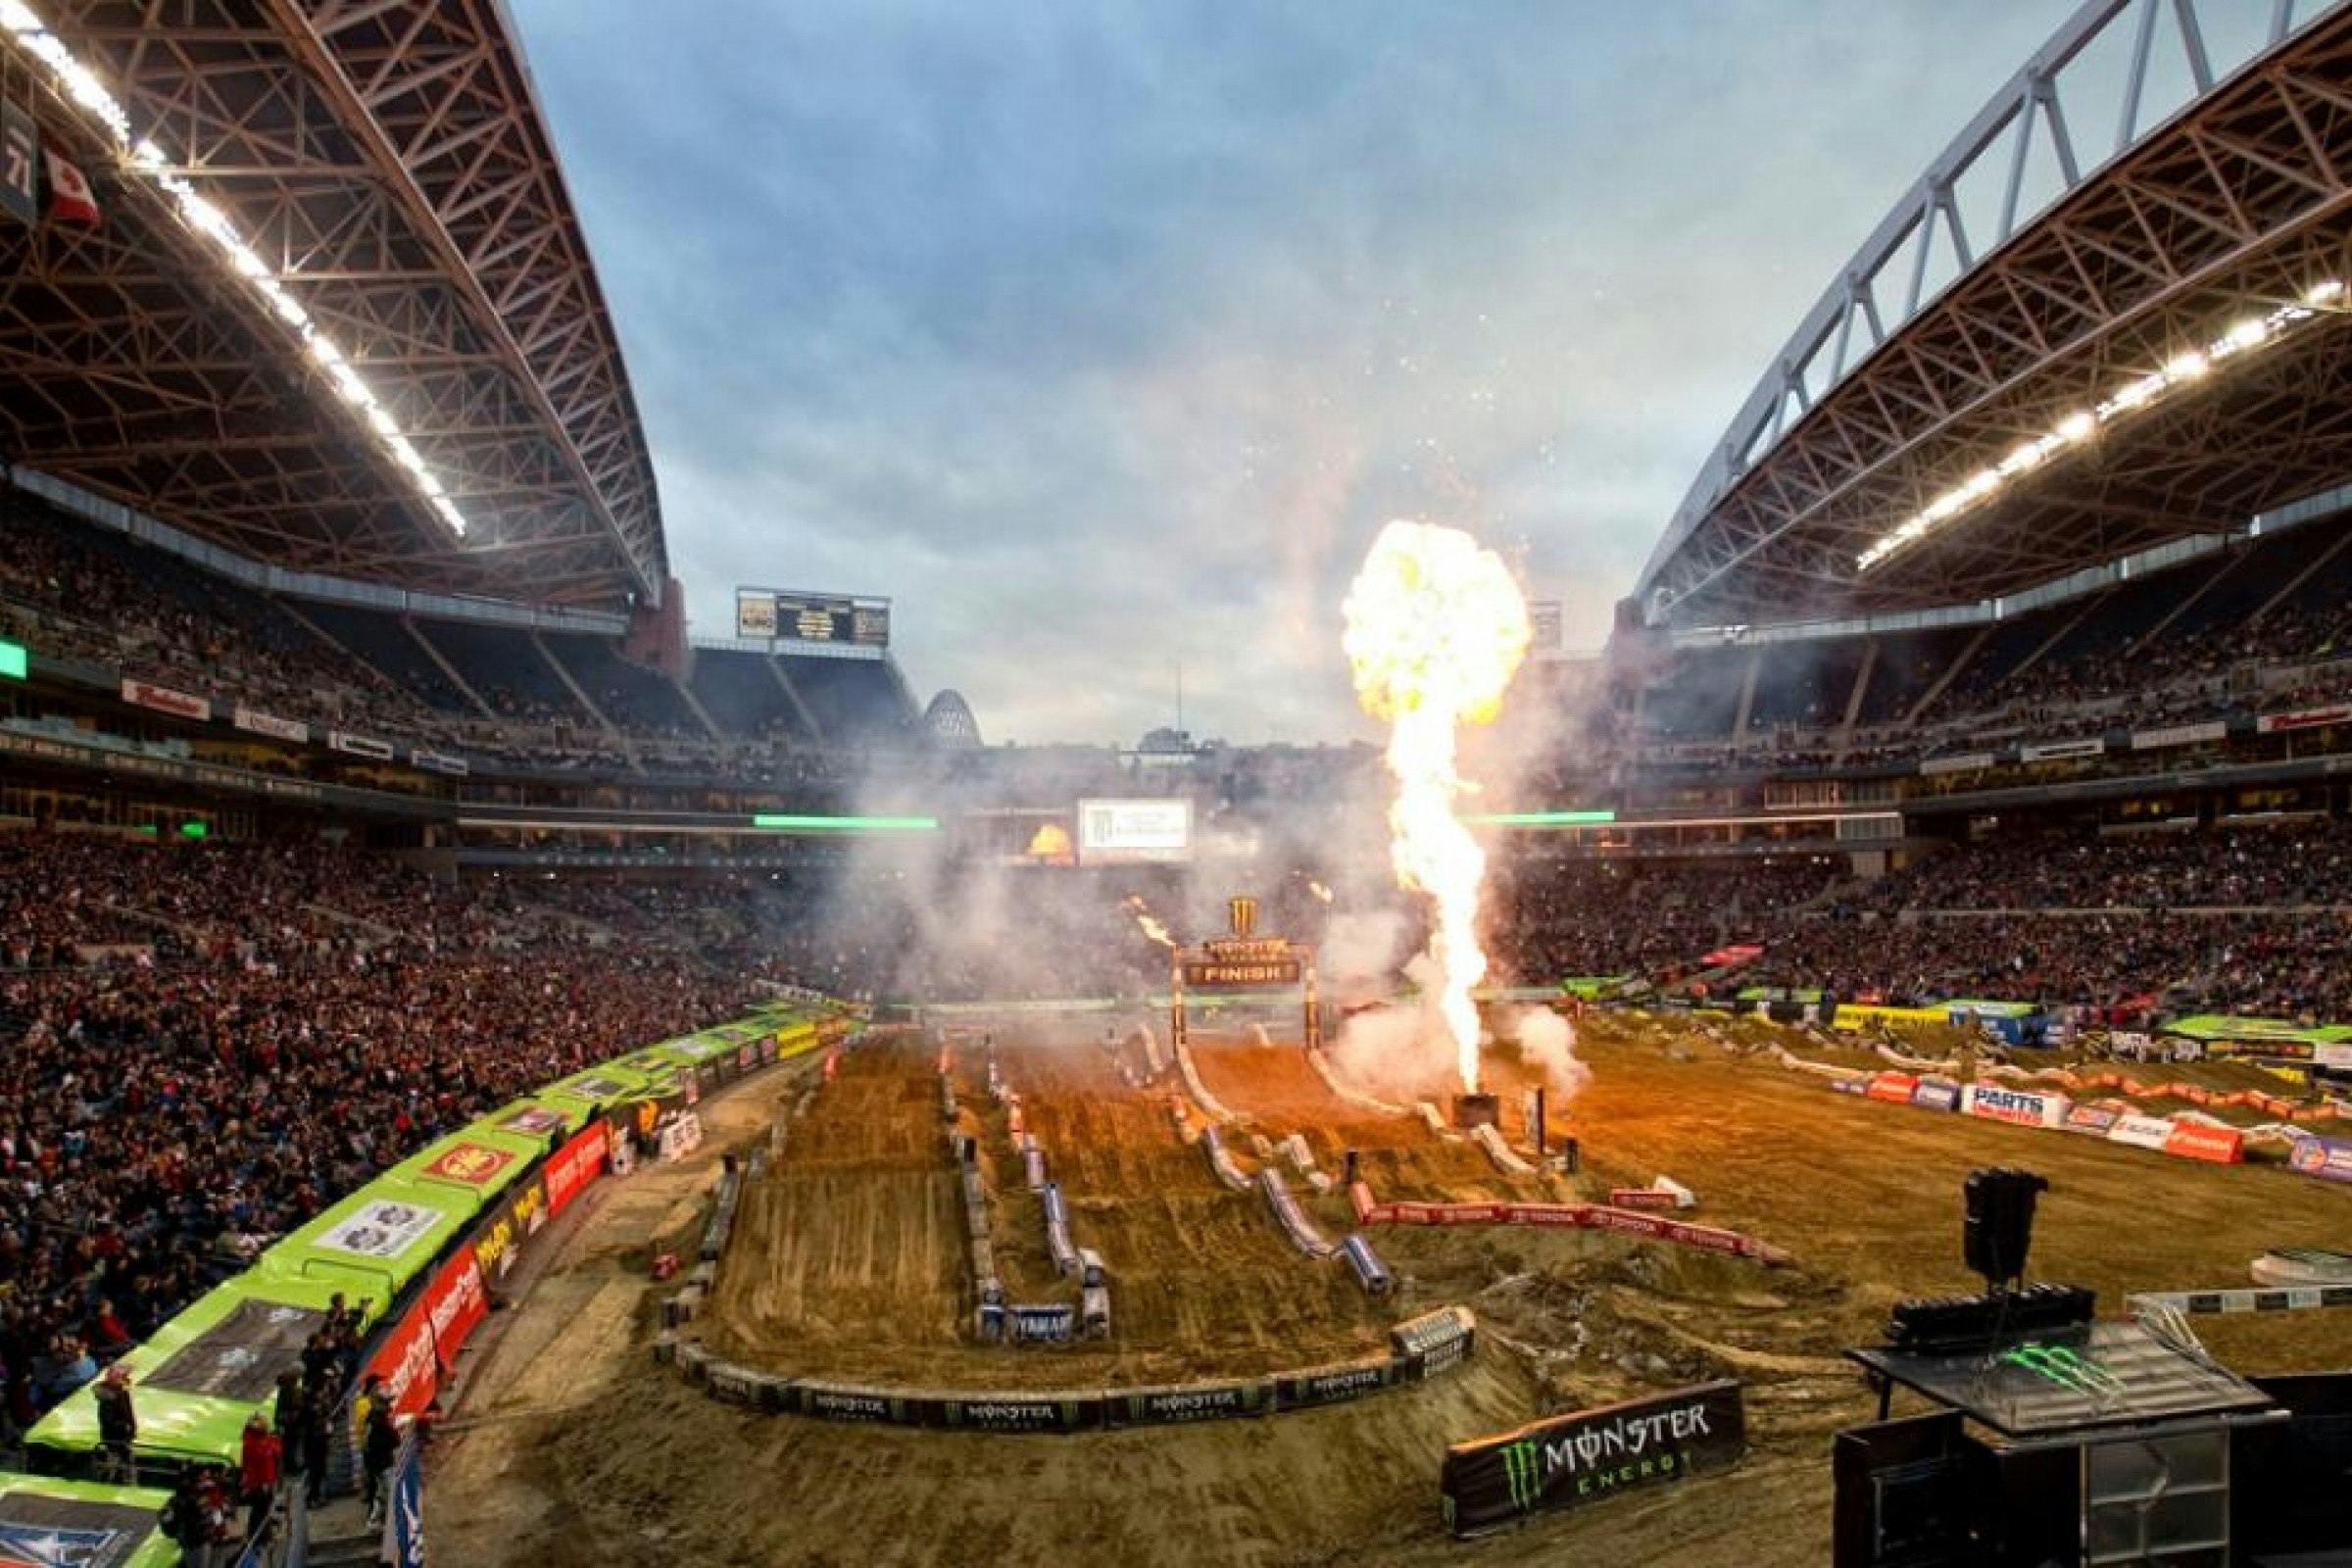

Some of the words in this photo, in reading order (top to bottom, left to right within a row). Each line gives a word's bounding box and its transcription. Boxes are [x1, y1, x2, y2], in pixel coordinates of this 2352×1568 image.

[1204, 965, 1281, 981] FINISH
[1974, 1087, 2044, 1113] PARTS
[968, 1404, 1054, 1419] MONSTER
[1152, 1393, 1236, 1411] MONSTER
[1544, 1403, 1711, 1473] MONSTER
[1576, 1450, 1692, 1495] ENERGY
